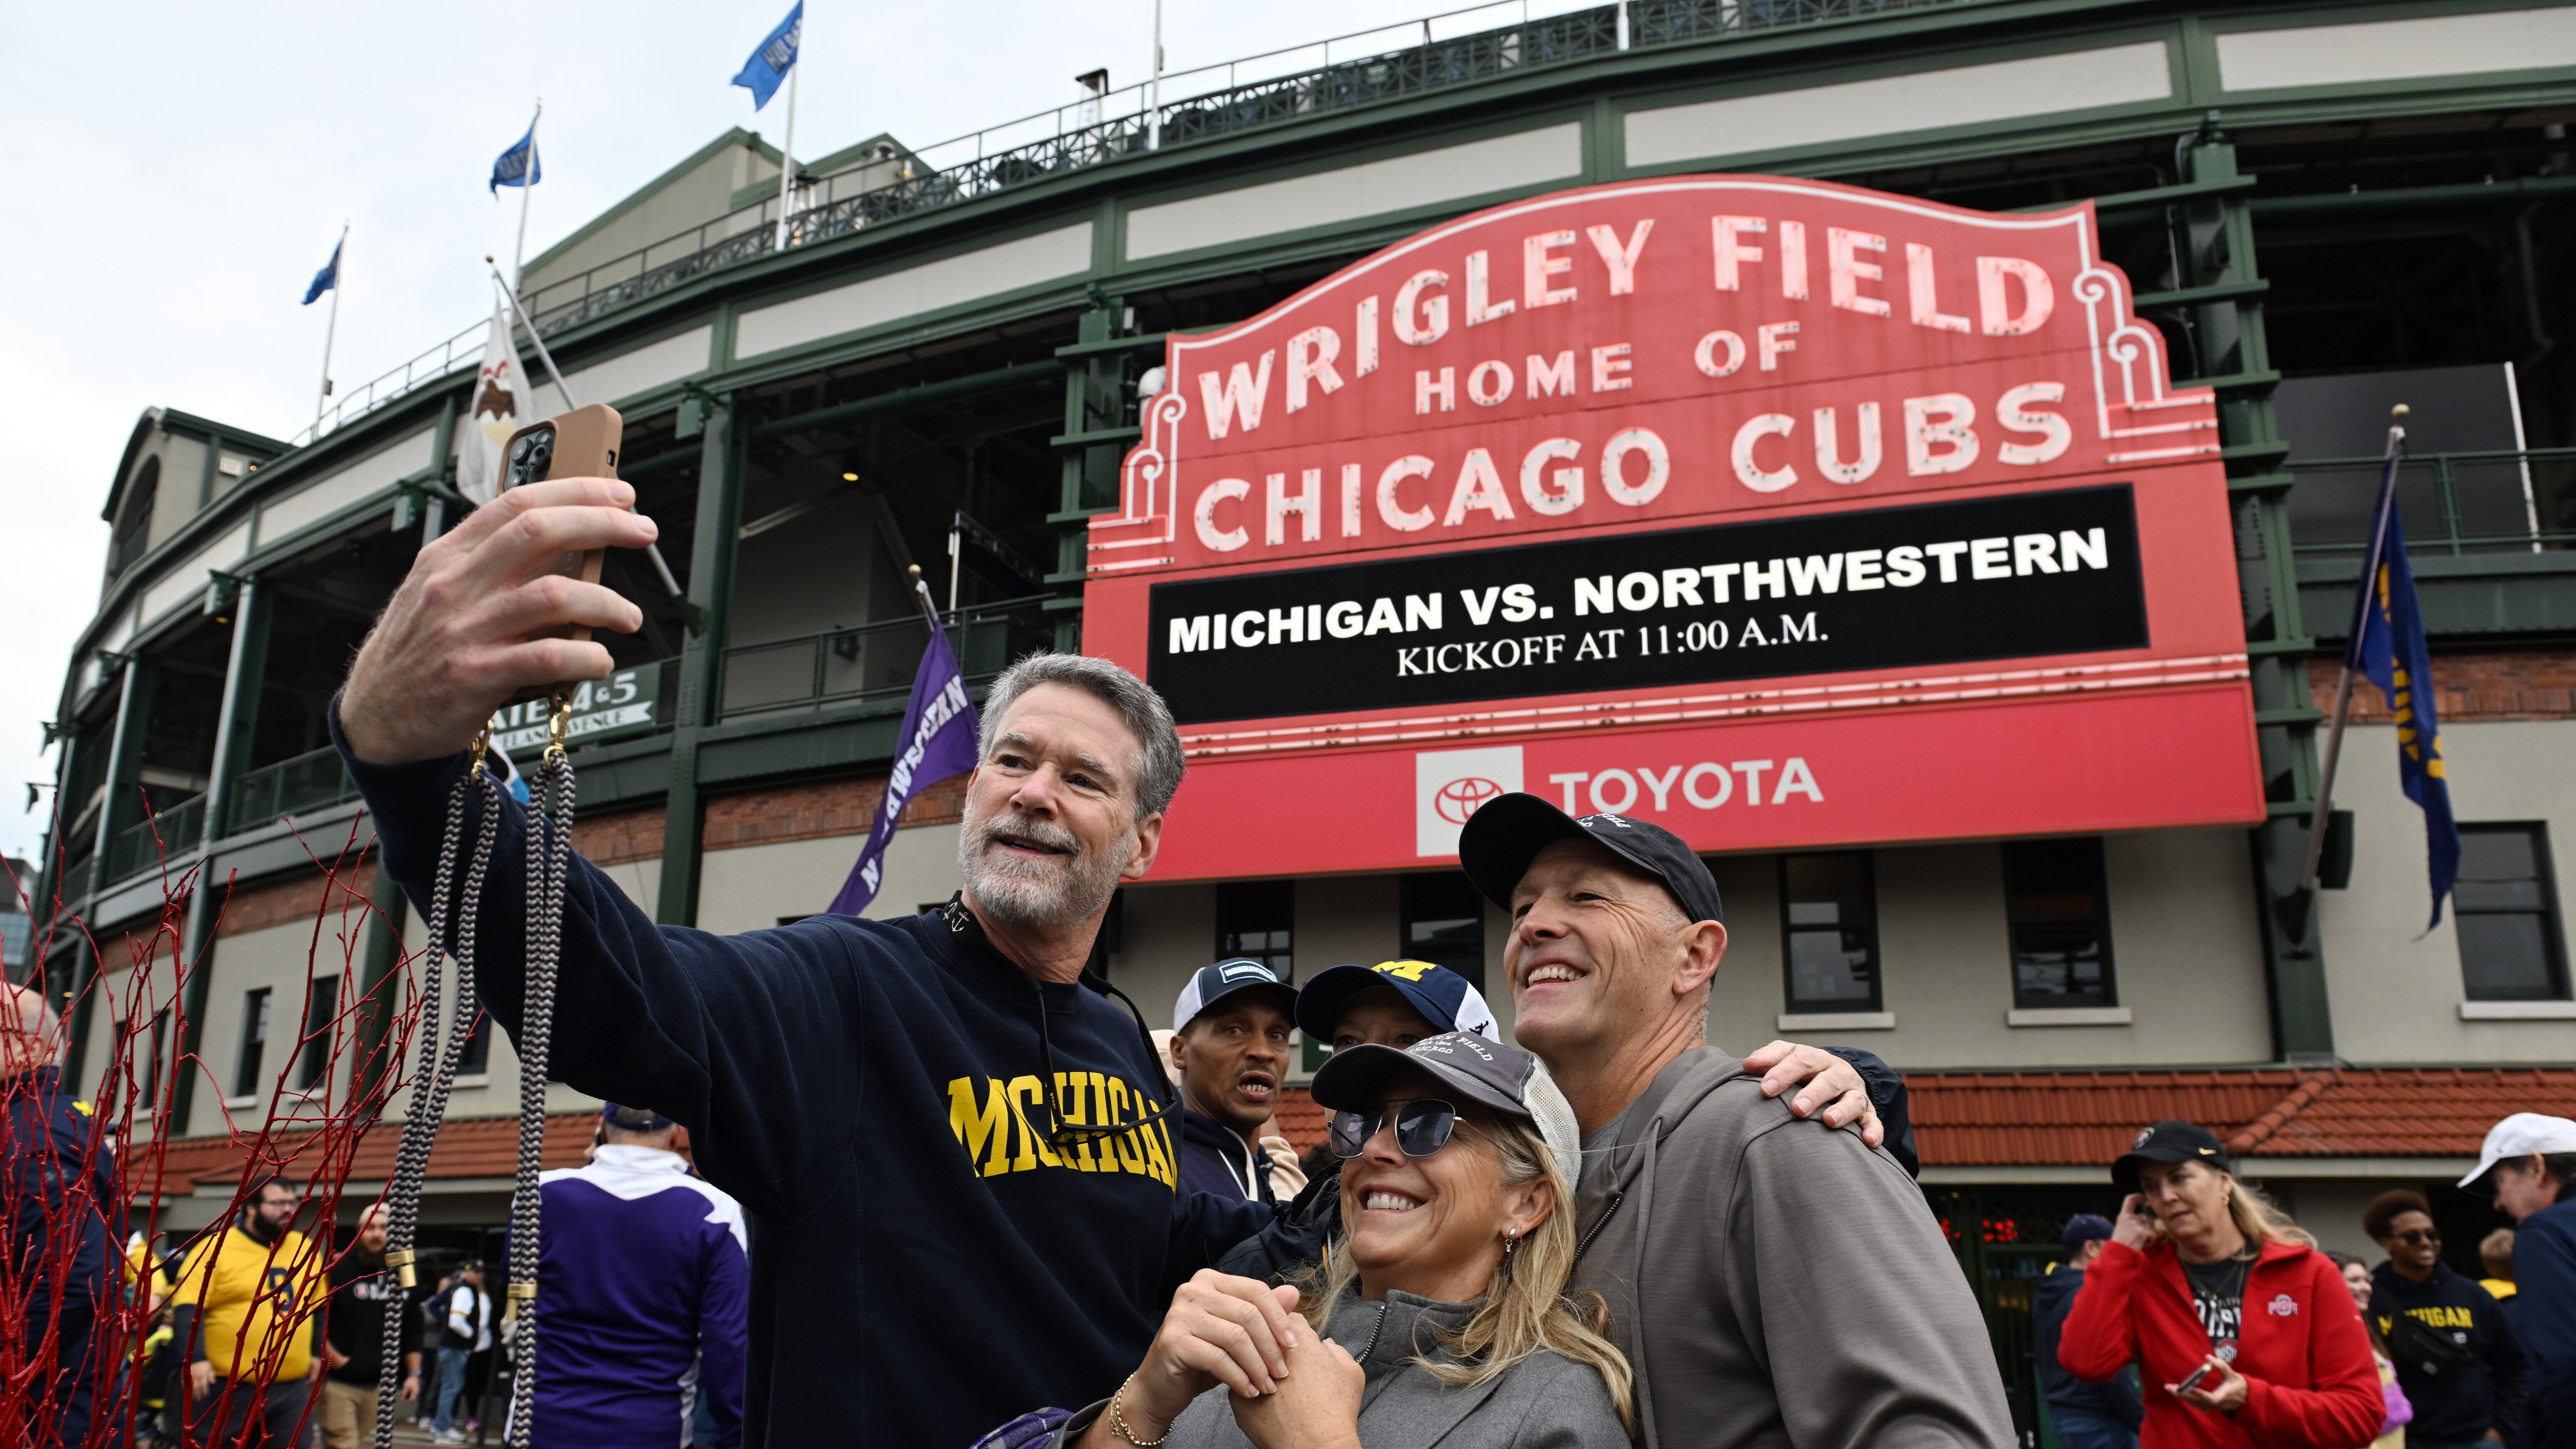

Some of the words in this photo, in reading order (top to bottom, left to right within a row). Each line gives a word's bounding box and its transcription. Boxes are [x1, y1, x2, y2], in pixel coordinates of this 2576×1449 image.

[1198, 219, 1654, 440] WRIGLEY
[1712, 214, 2054, 336] FIELD
[1415, 343, 1632, 415] HOME
[1694, 320, 1800, 377] OF
[1194, 426, 1669, 552] CHICAGO
[1731, 381, 2072, 493] CUBS
[1169, 592, 1442, 654] MICHIGAN
[1461, 583, 1554, 625] VS.
[1574, 528, 2108, 616] NORTHWESTERN
[1397, 634, 1565, 676] KICKOFF
[1575, 629, 1624, 661] AT
[1639, 620, 1729, 655] 11:00
[1738, 612, 1828, 647] A.M.
[1549, 757, 1824, 816] TOYOTA
[1371, 961, 1437, 982] M
[1456, 1037, 1494, 1061] FIELD
